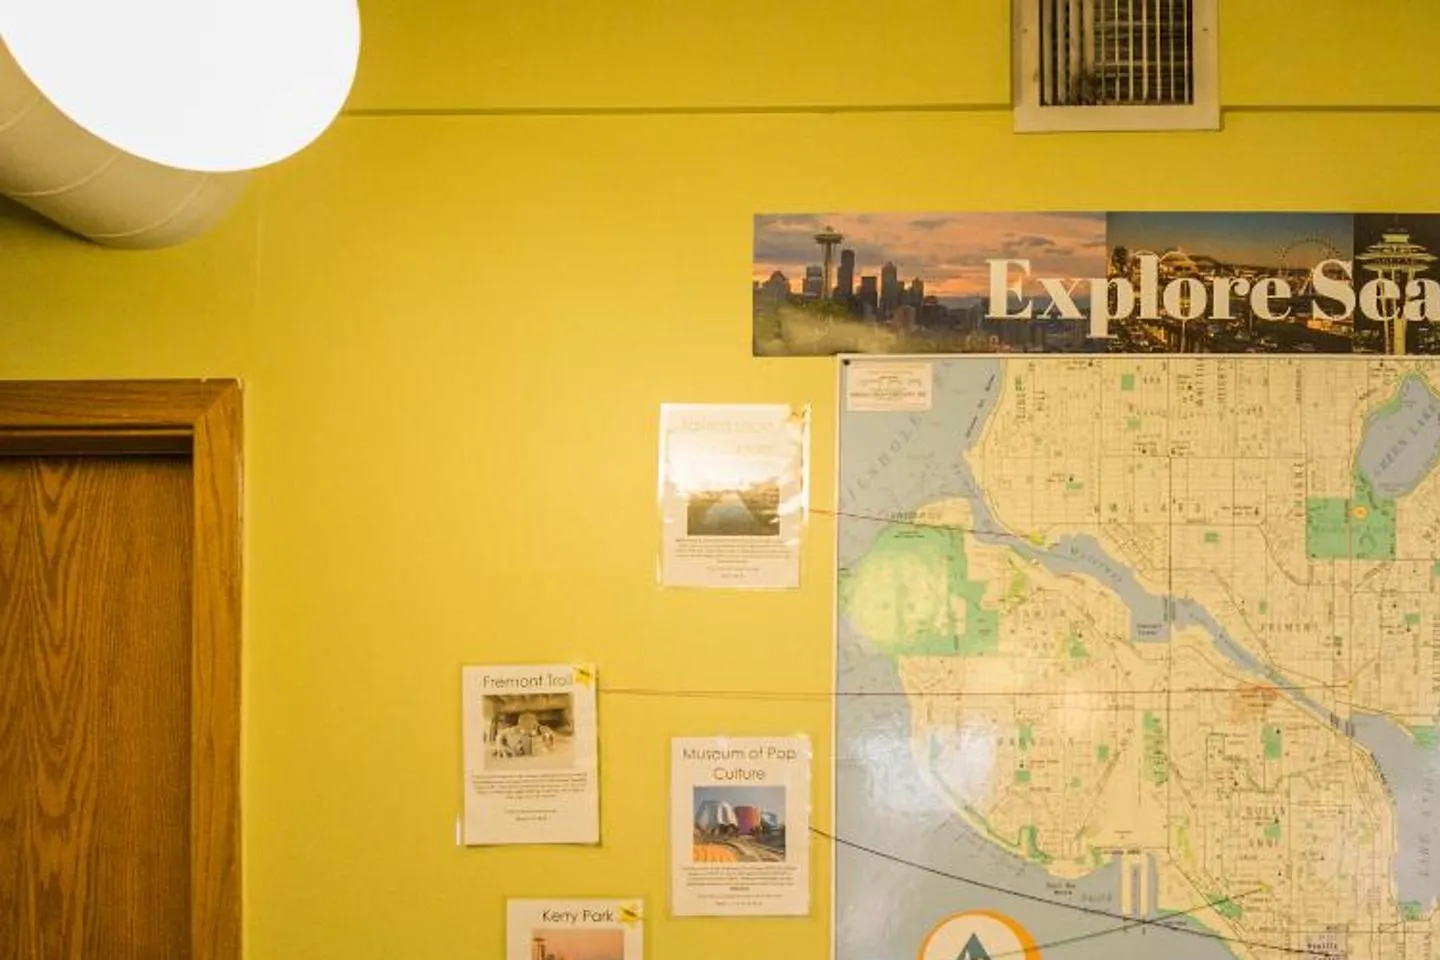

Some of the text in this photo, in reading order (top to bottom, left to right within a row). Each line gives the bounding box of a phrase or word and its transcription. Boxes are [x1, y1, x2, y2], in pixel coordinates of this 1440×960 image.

[984, 251, 1293, 340] Explore
[483, 674, 543, 689] Fremont
[683, 747, 797, 762] Museum of Pop
[714, 767, 765, 780] Culture
[543, 909, 613, 923] Kerry Park
